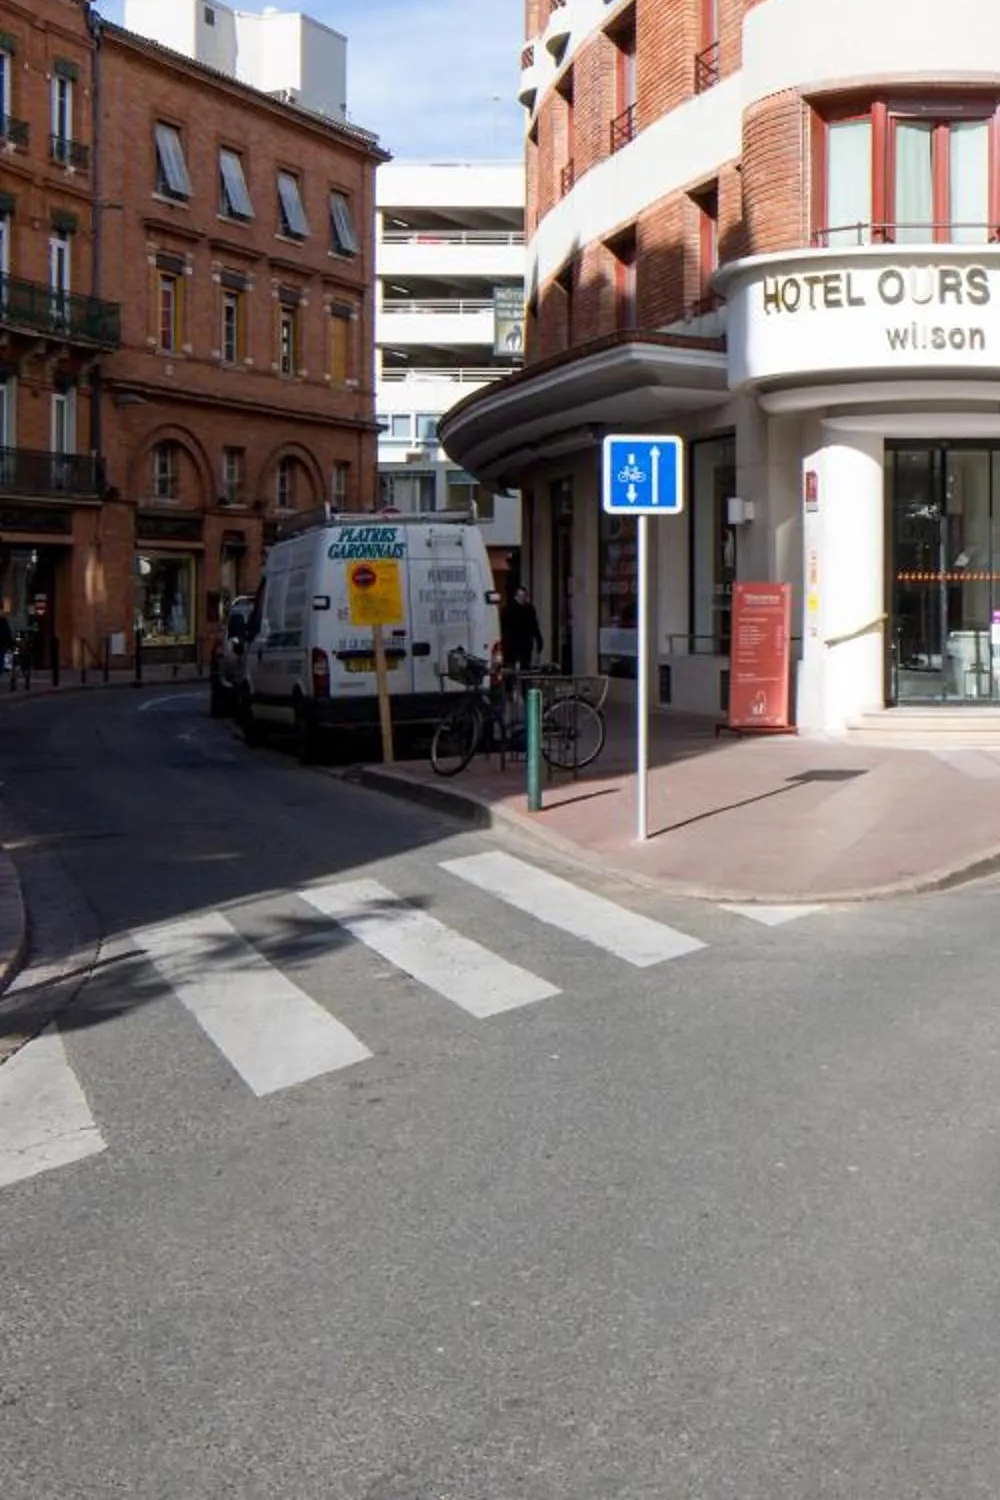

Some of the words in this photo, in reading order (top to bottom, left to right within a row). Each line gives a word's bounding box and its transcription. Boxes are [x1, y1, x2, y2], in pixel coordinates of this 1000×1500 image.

[762, 272, 866, 316] HOTEL
[877, 267, 991, 306] OURS
[886, 320, 986, 351] wilson
